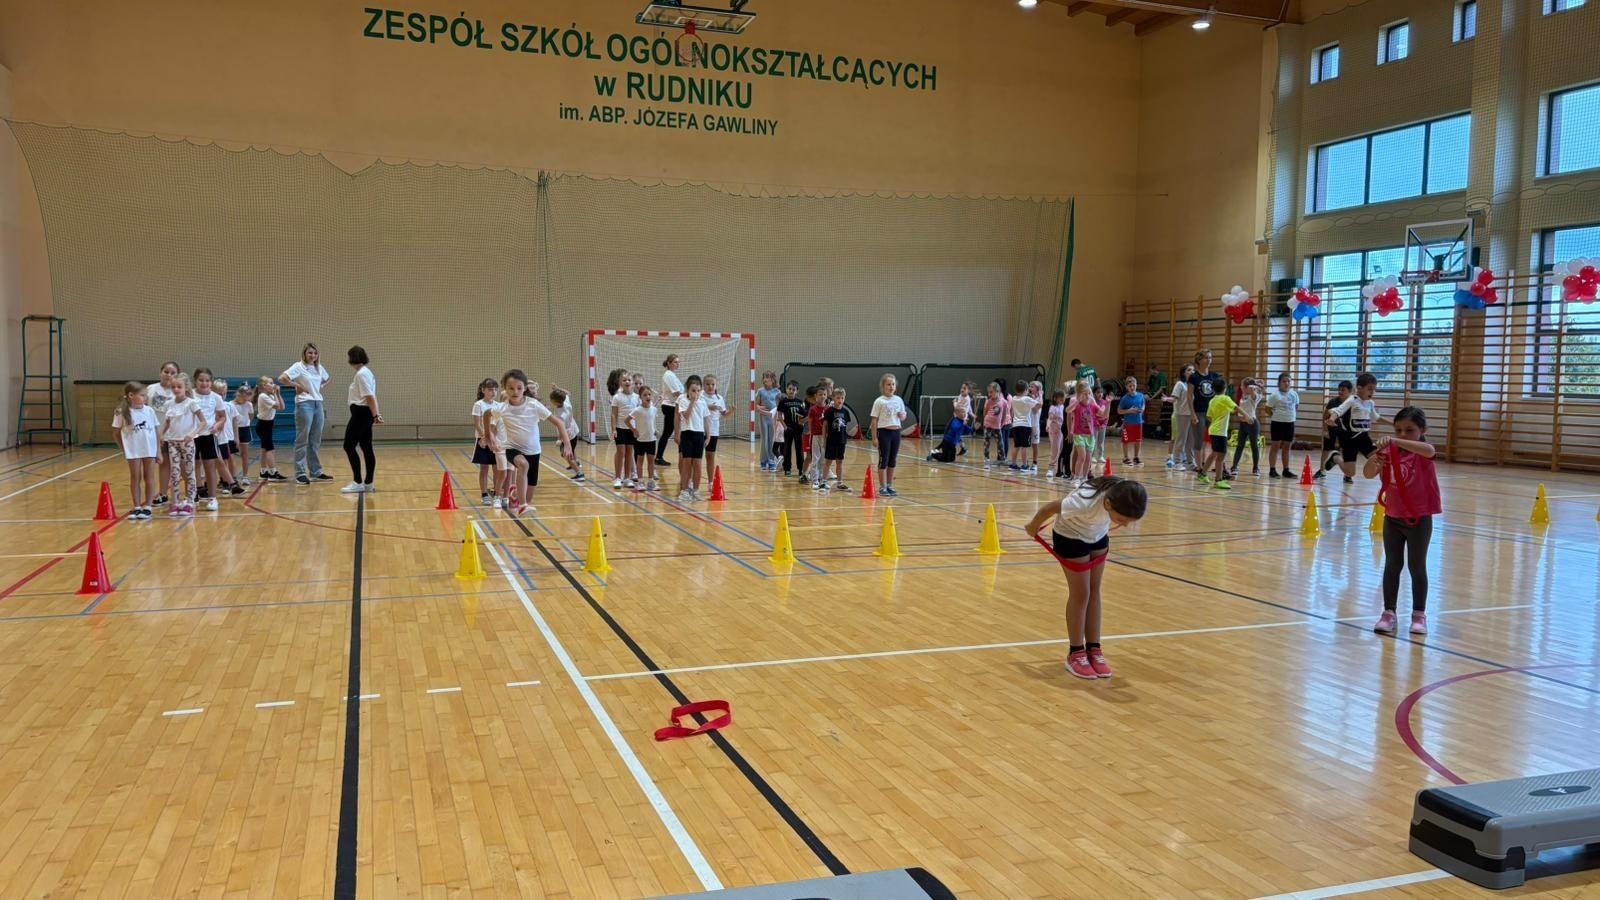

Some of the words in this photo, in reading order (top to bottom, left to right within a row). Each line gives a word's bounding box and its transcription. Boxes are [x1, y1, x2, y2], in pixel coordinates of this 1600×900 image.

[363, 7, 493, 50] ZESPÓŁ
[500, 22, 602, 60] SZKÓŁ
[594, 75, 616, 97] w
[626, 72, 752, 109] RUDNIKU
[559, 102, 584, 121] im.
[588, 105, 628, 125] ABP.
[633, 106, 699, 130] JÓZEFA
[703, 114, 778, 136] GAWLINY
